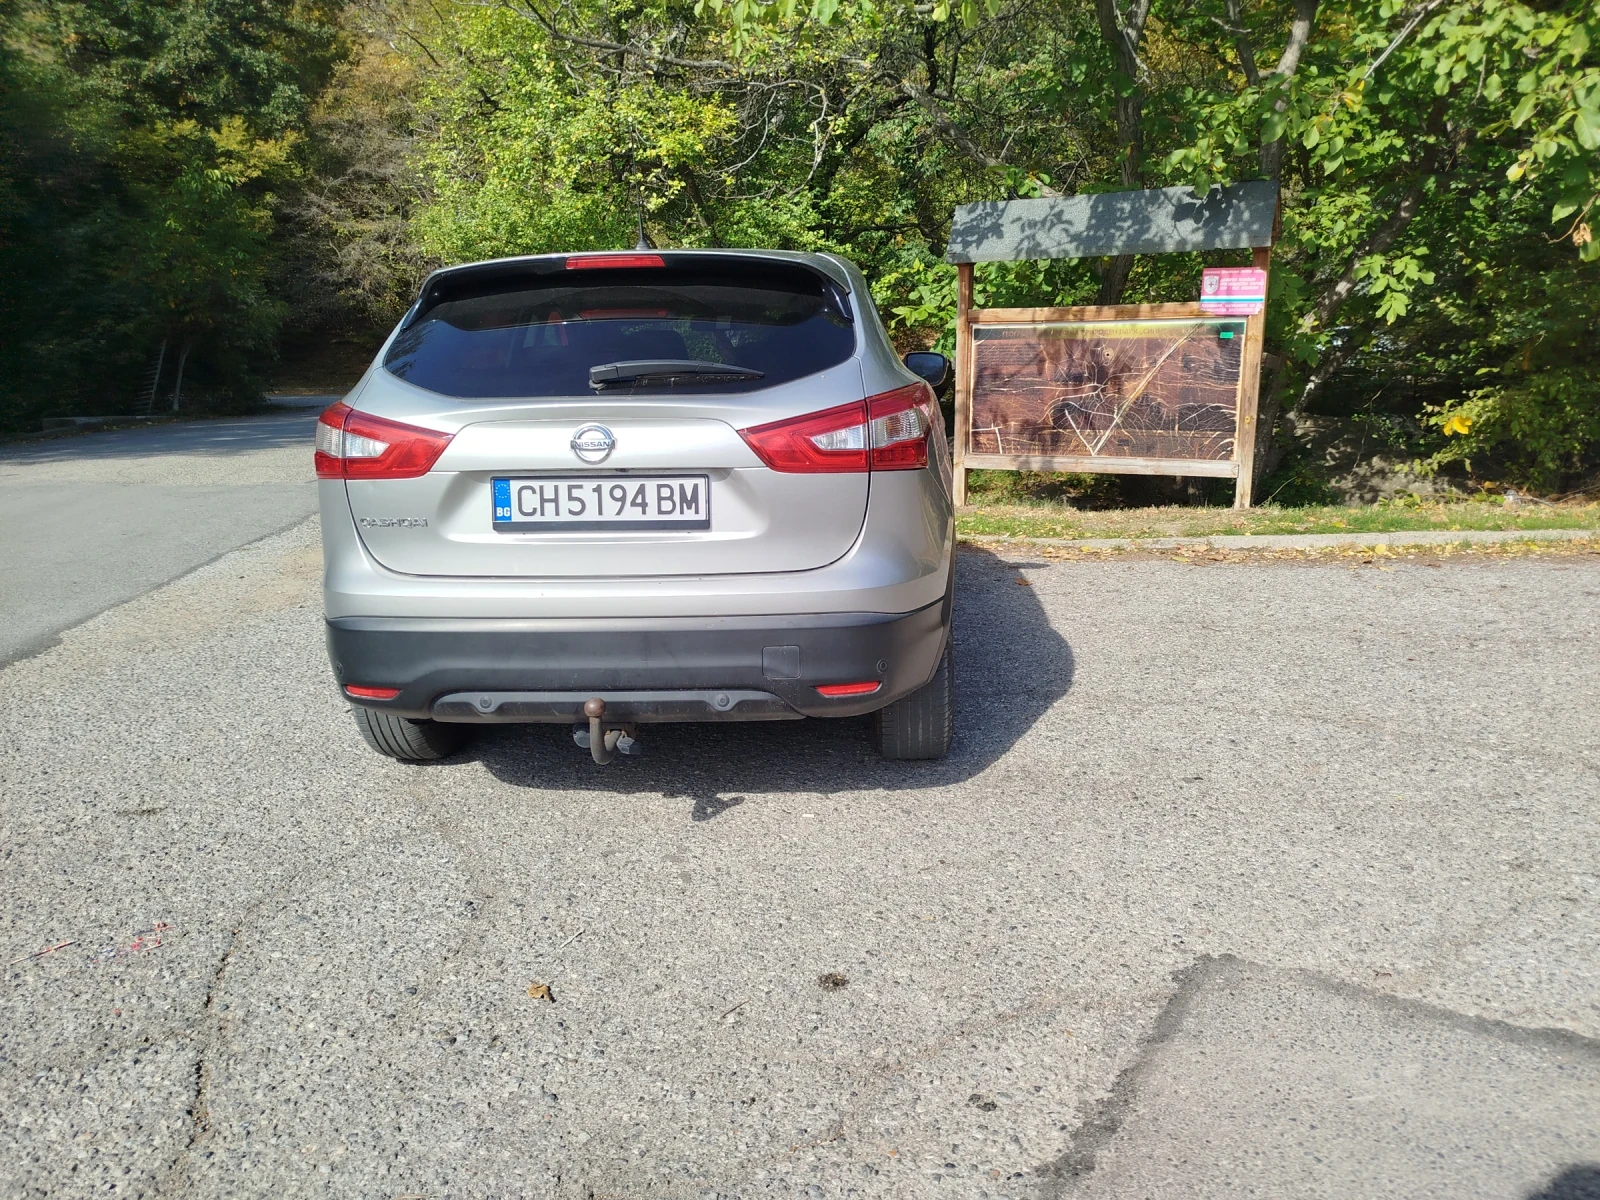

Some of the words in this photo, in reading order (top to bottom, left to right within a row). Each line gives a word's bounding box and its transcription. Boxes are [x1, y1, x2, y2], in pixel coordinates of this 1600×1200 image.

[573, 440, 611, 448] NISSAN
[496, 507, 511, 517] BG
[360, 517, 429, 529] QASHQAI
